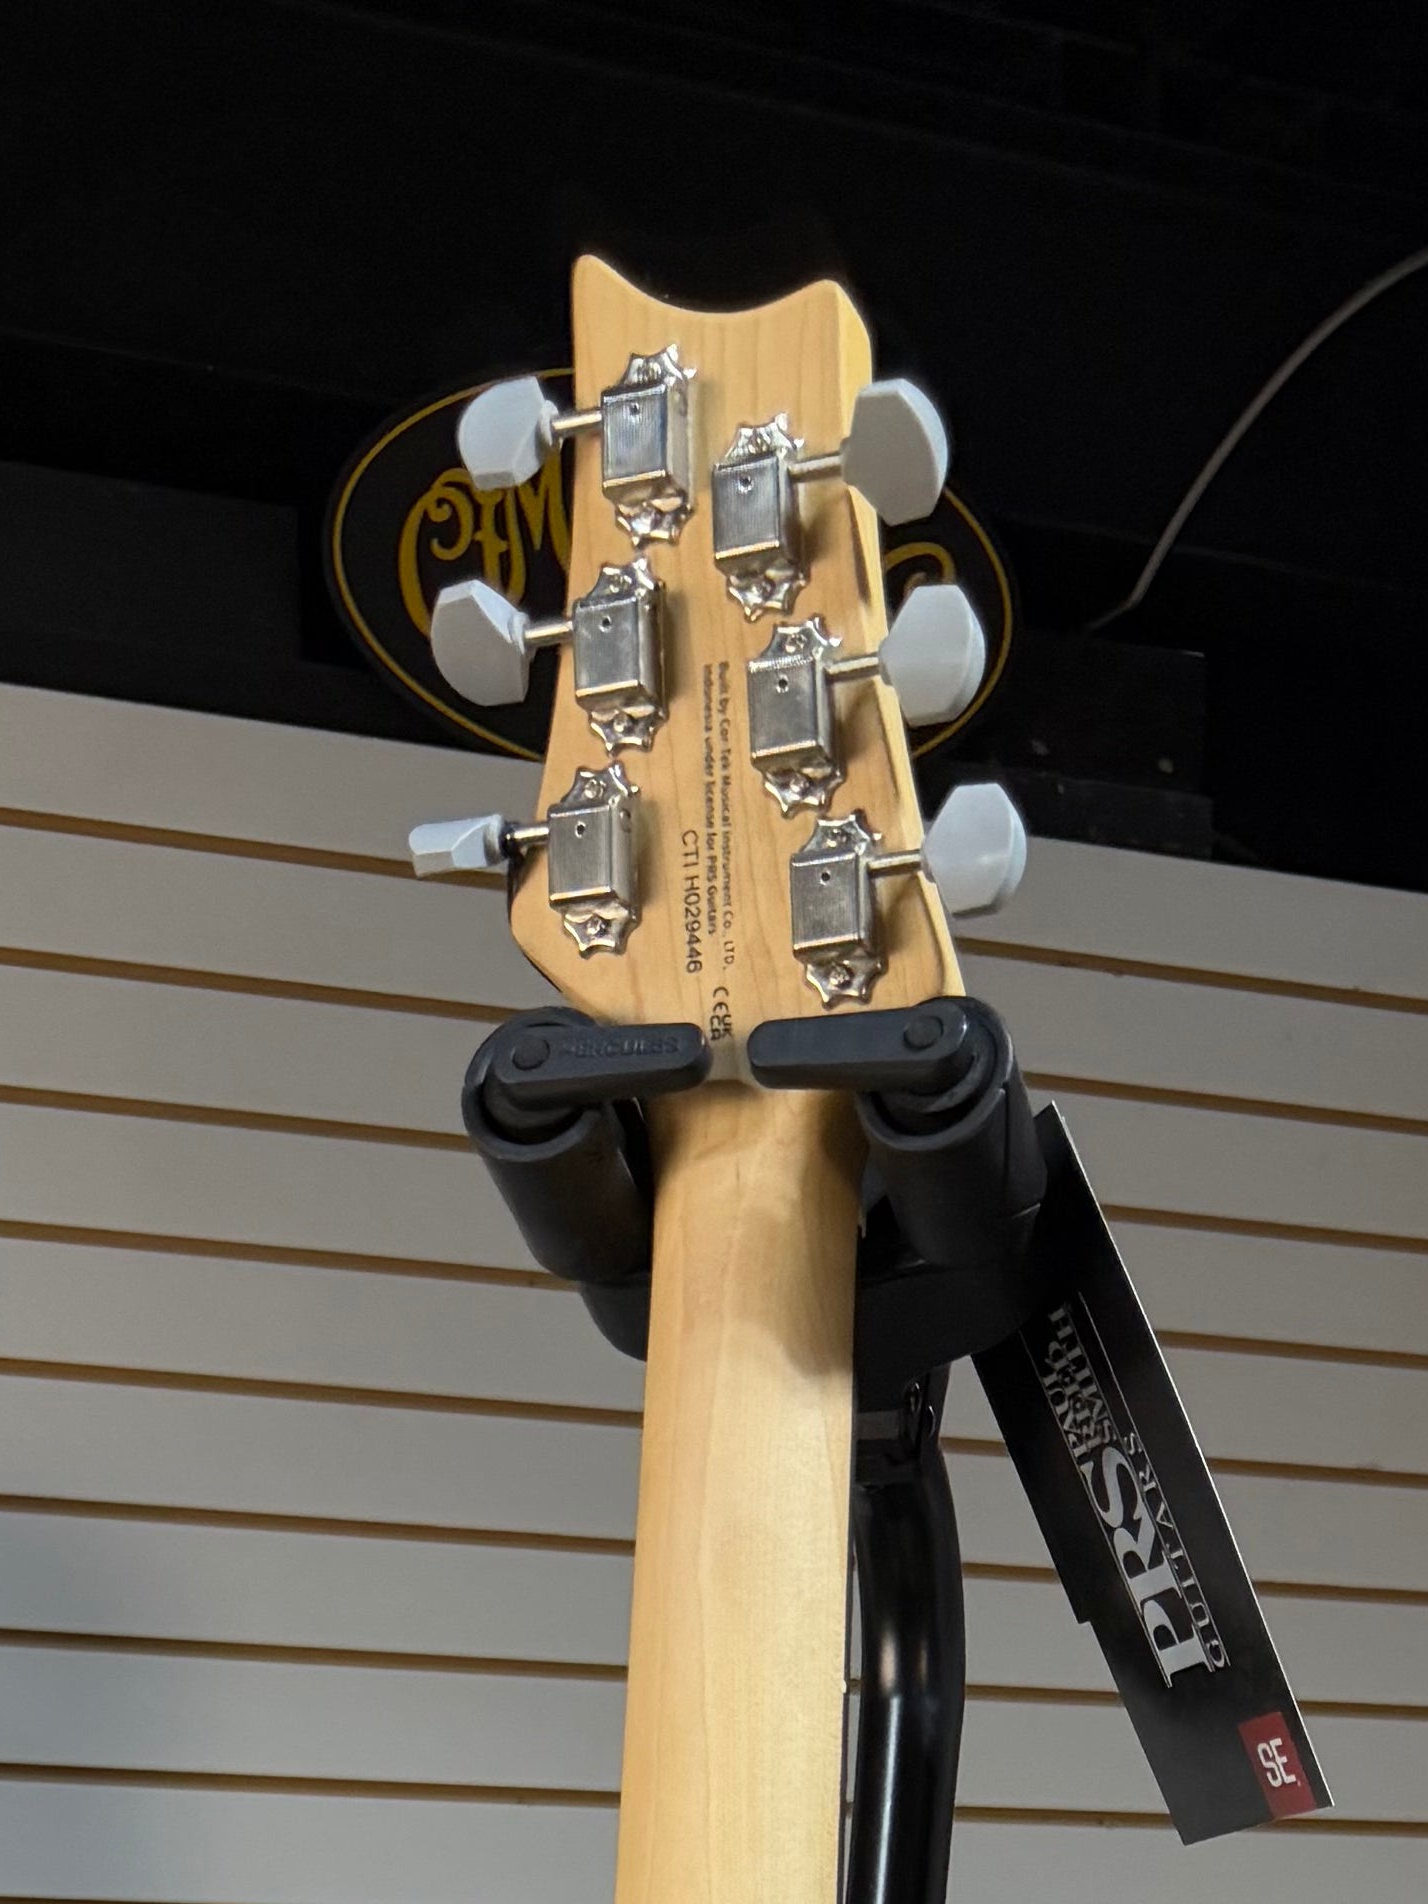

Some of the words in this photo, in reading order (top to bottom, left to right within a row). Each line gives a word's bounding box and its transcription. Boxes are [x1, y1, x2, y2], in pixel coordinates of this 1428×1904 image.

[681, 829, 699, 867] CTI
[684, 874, 703, 974] H029446
[1081, 1446, 1214, 1688] PRS
[1122, 1432, 1229, 1670] GUITARS
[1257, 1736, 1297, 1788] SE
